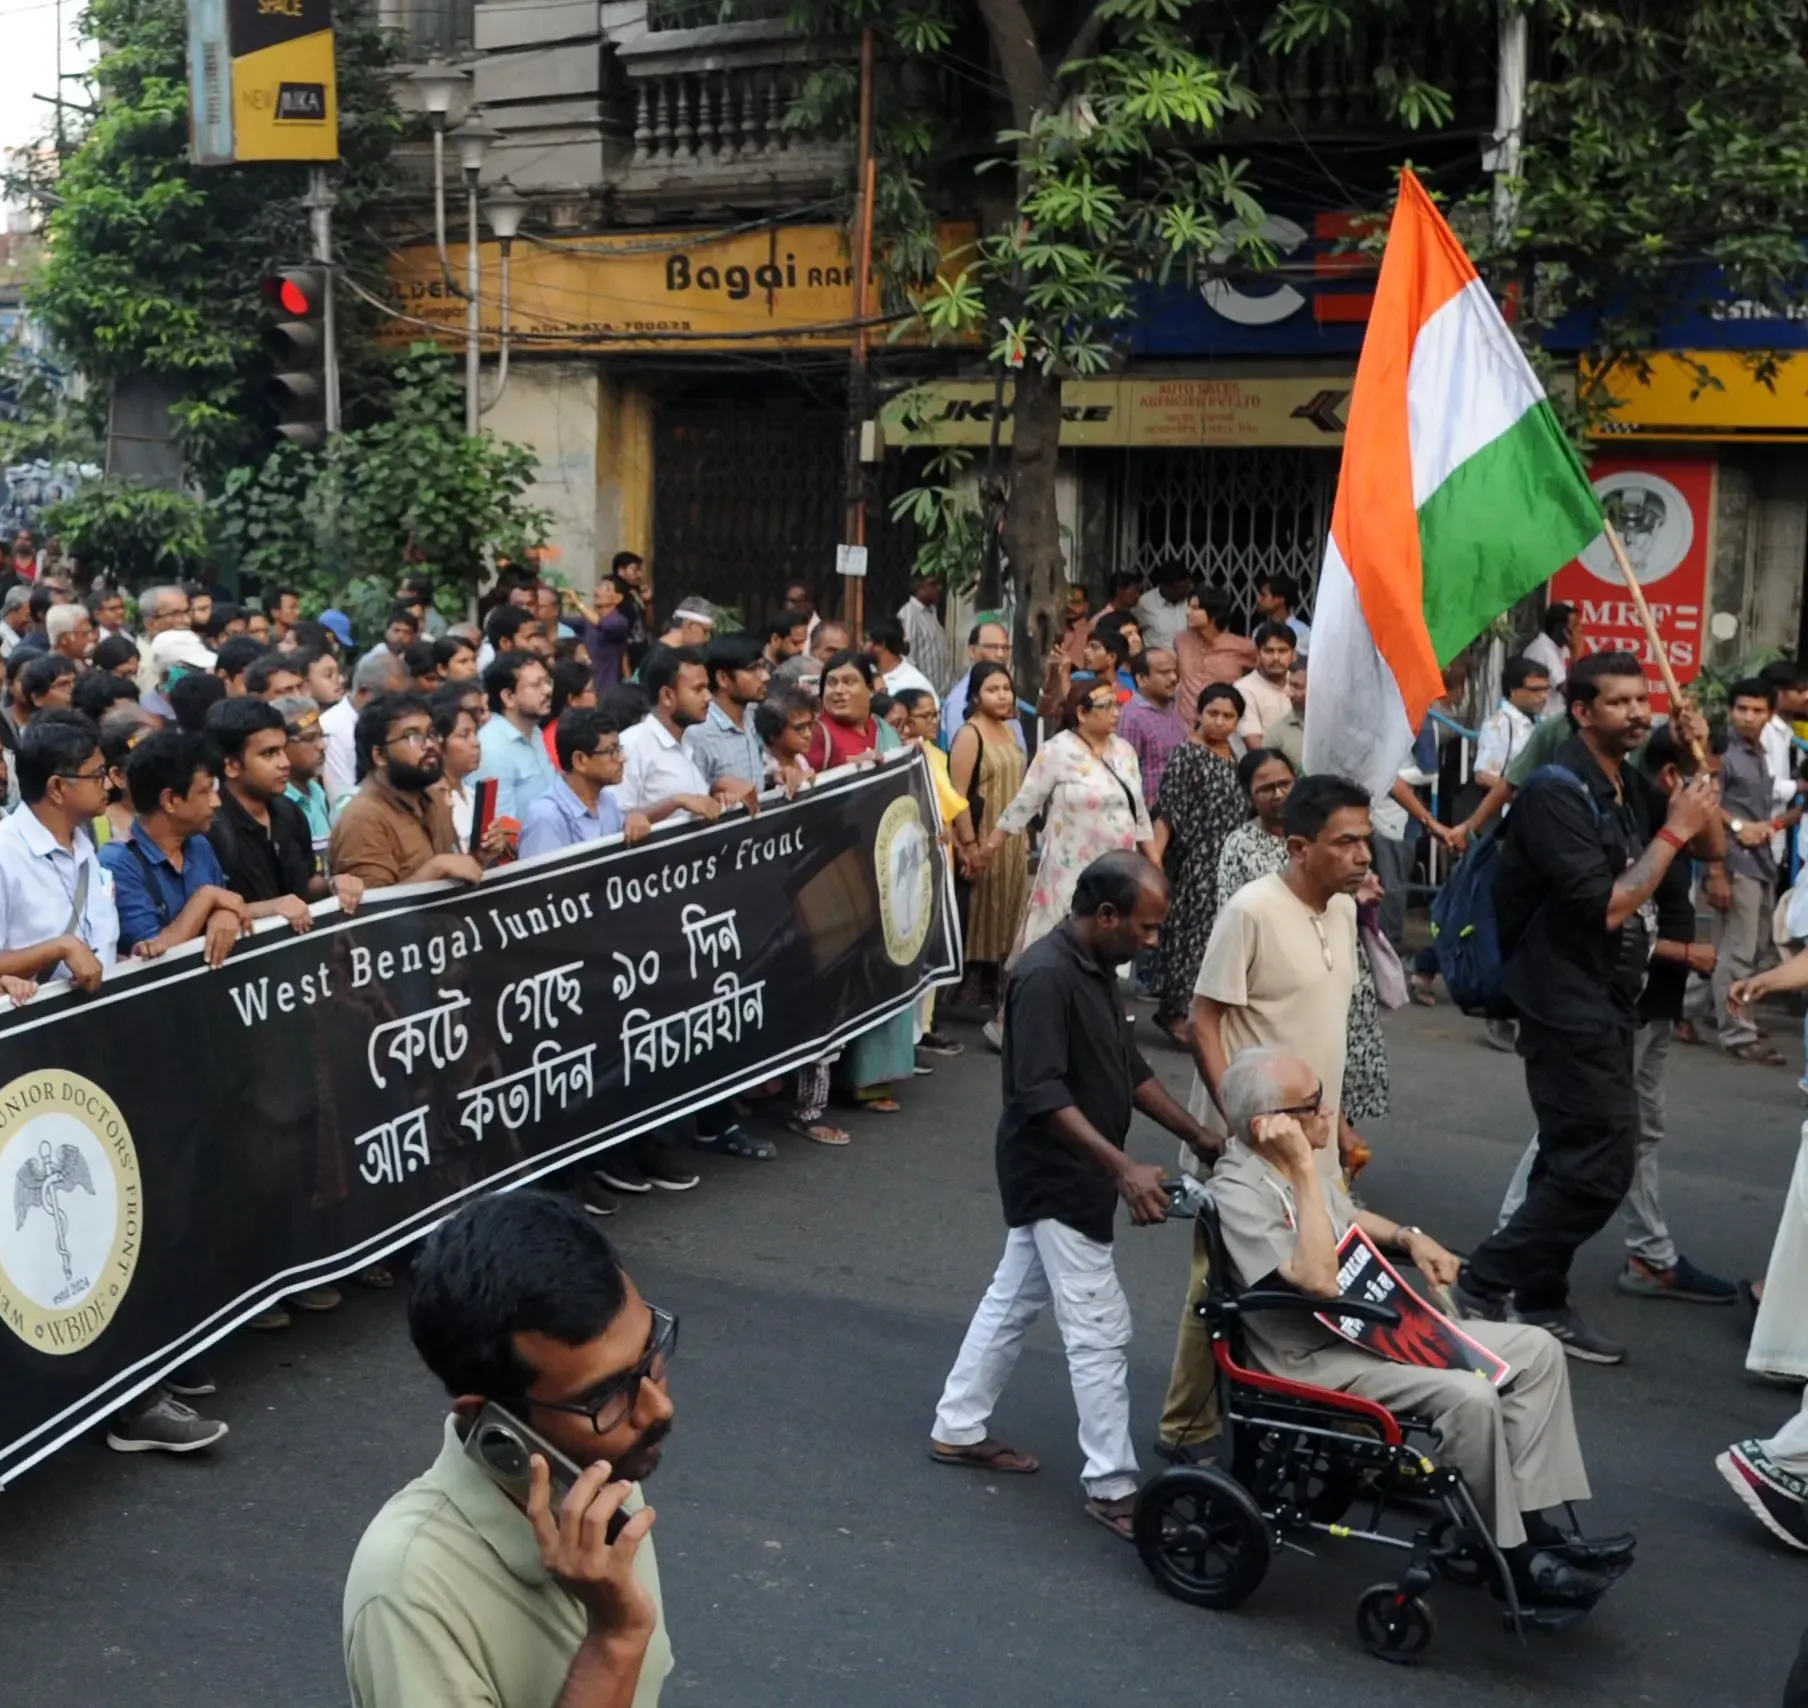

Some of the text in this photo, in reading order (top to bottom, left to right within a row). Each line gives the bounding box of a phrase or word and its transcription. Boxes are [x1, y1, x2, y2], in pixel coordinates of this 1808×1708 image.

[666, 252, 796, 299] Bagai
[1583, 636, 1693, 666] YRES
[230, 965, 333, 1027] West
[350, 916, 483, 988] Bengal
[491, 893, 594, 950] Junior
[734, 823, 806, 872] Front
[368, 904, 742, 1089] কেটে গেছে ৯০ দিন
[354, 971, 767, 1185] আর কতদিন বিচারহীন
[118, 1184, 138, 1277] FRONT
